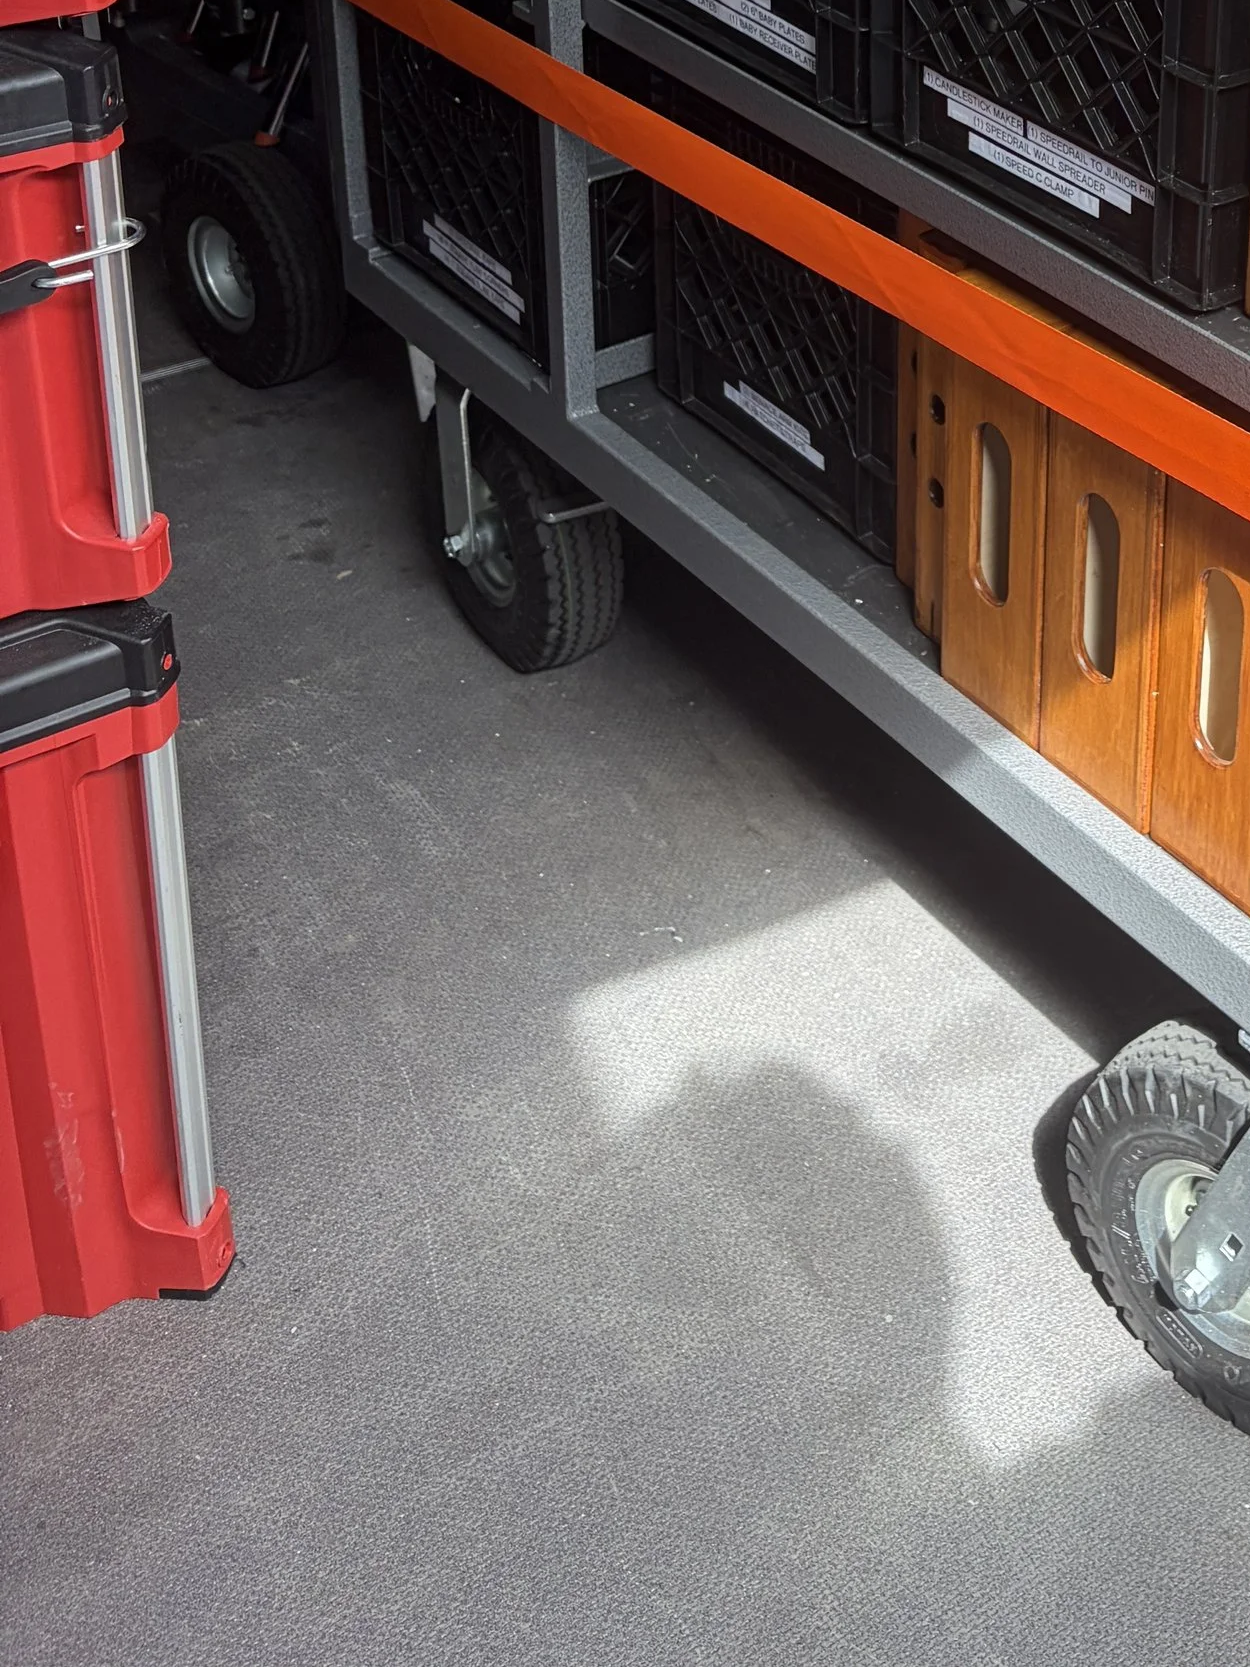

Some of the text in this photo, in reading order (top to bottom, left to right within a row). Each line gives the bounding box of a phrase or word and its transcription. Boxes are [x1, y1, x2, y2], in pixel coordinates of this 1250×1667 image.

[739, 18, 758, 34] BABY
[759, 30, 794, 56] RECEIVER
[758, 11, 777, 27] BABY
[779, 22, 806, 45] PLATES
[935, 77, 992, 113] CANDLESTICK
[993, 107, 1023, 131] MAKER
[973, 115, 1106, 195] (1) SPEEDRAIL WALL SPREADER
[993, 149, 1005, 164] (1)
[1005, 155, 1035, 179] SPEED
[1043, 177, 1075, 199] CLAMP
[1040, 133, 1089, 167] SPEEDRAIL
[1090, 158, 1103, 173] TO
[1104, 165, 1138, 192] JUNIOR
[1139, 184, 1154, 201] PIN
